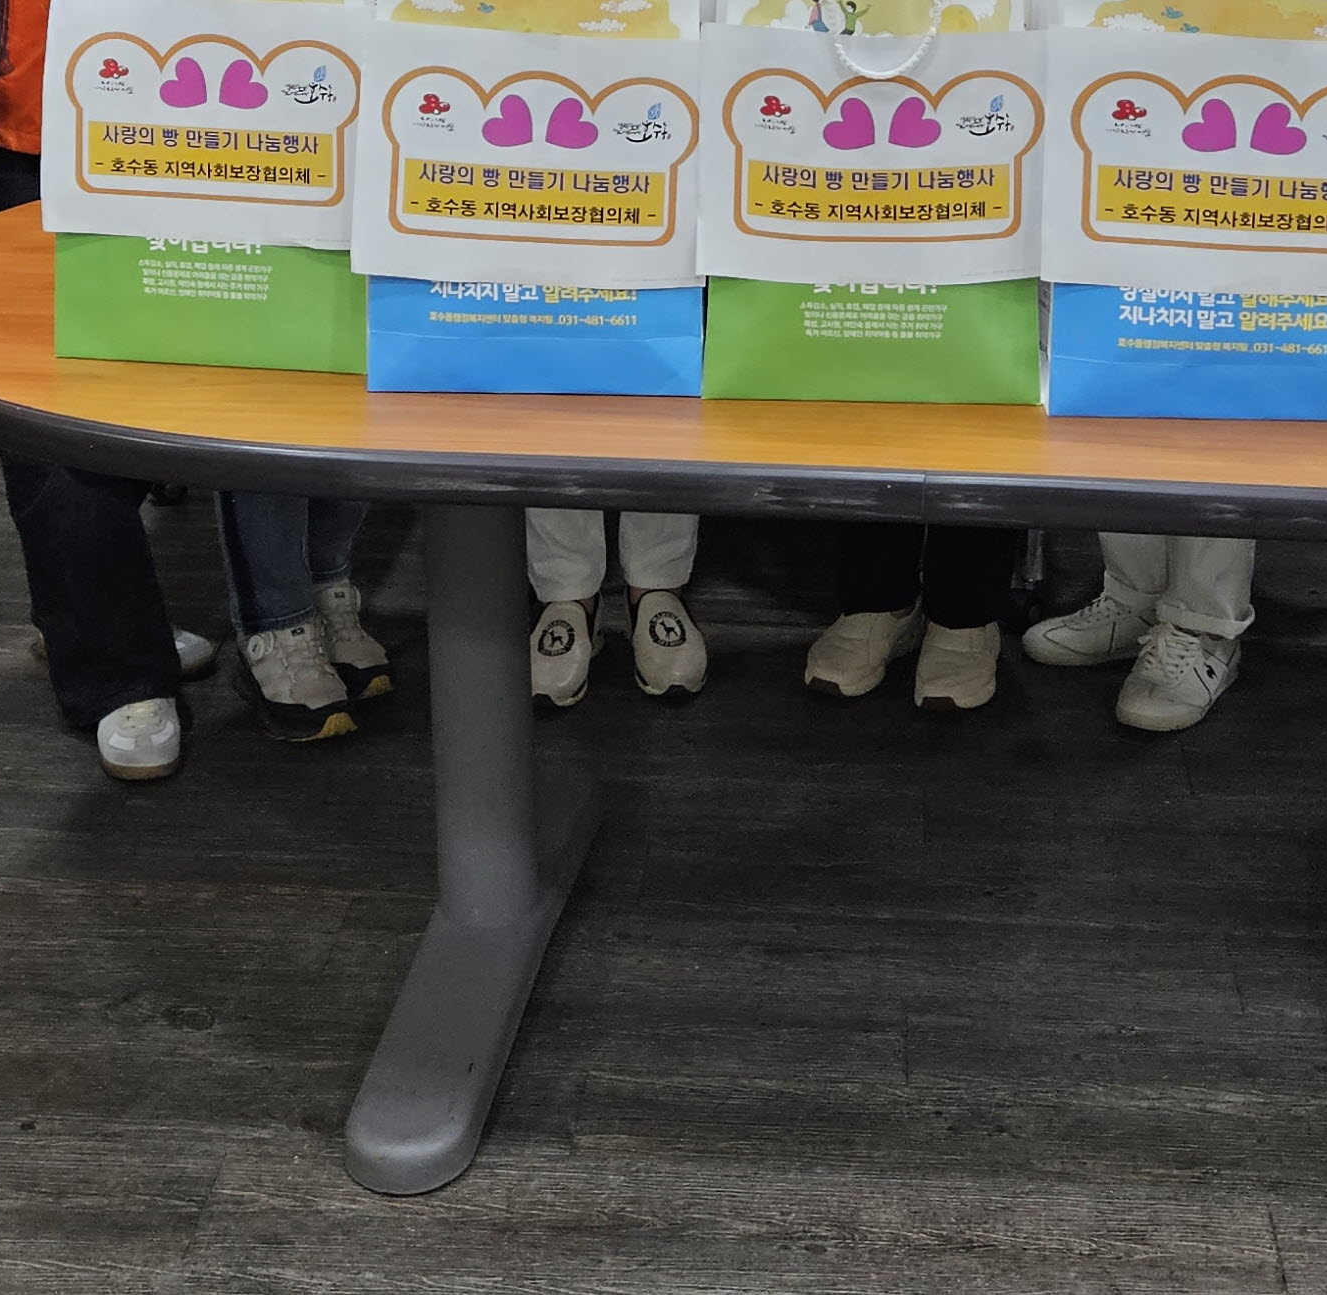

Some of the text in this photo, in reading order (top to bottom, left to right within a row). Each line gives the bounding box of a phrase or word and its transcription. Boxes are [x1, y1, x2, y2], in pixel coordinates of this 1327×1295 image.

[103, 126, 318, 154] 사랑의 빵 만들기 나눔행사
[111, 158, 310, 184] 호수동 지역사회보장협의체
[419, 163, 649, 193] 사랑의 빵 만들기 나눔행사
[763, 165, 994, 190] 사랑의 빵 만들기 나눔행사
[1114, 169, 1173, 190] 사랑의
[1183, 174, 1201, 193] 빵
[1211, 176, 1269, 198] 만들기
[426, 198, 639, 224] 호수동 지역사회보장협의체
[770, 200, 985, 220] 호수동 지역사회보장협의체
[1122, 204, 1176, 223] 호수동
[502, 283, 539, 303] 말고
[1119, 305, 1193, 328] 지나치지
[1197, 310, 1235, 330] 말고
